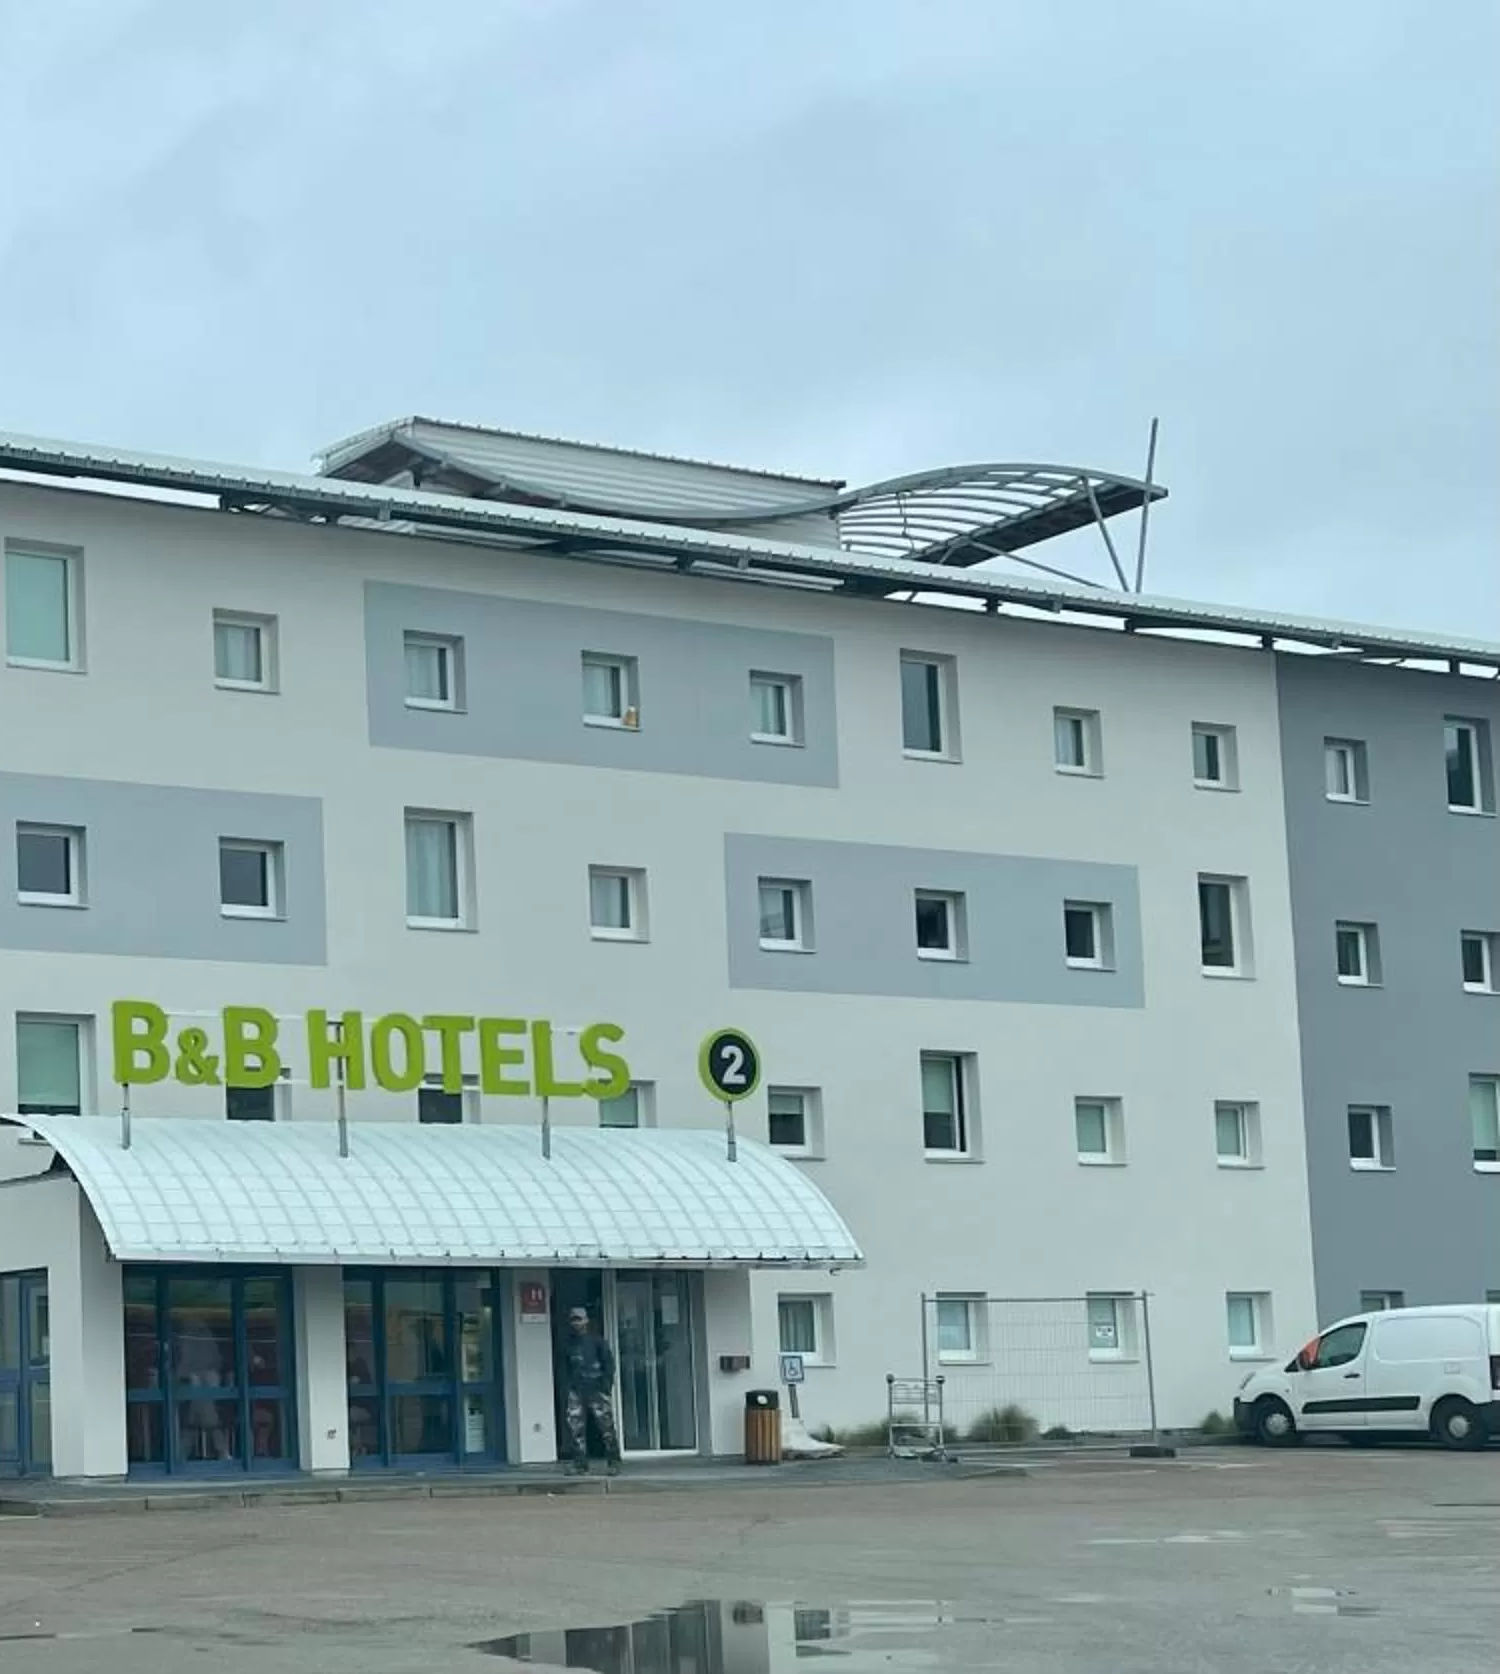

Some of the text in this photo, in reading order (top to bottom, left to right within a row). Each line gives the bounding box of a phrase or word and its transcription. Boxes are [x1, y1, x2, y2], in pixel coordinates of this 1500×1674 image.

[113, 1001, 630, 1099] B&B HOTELS
[721, 1045, 746, 1085] 2
